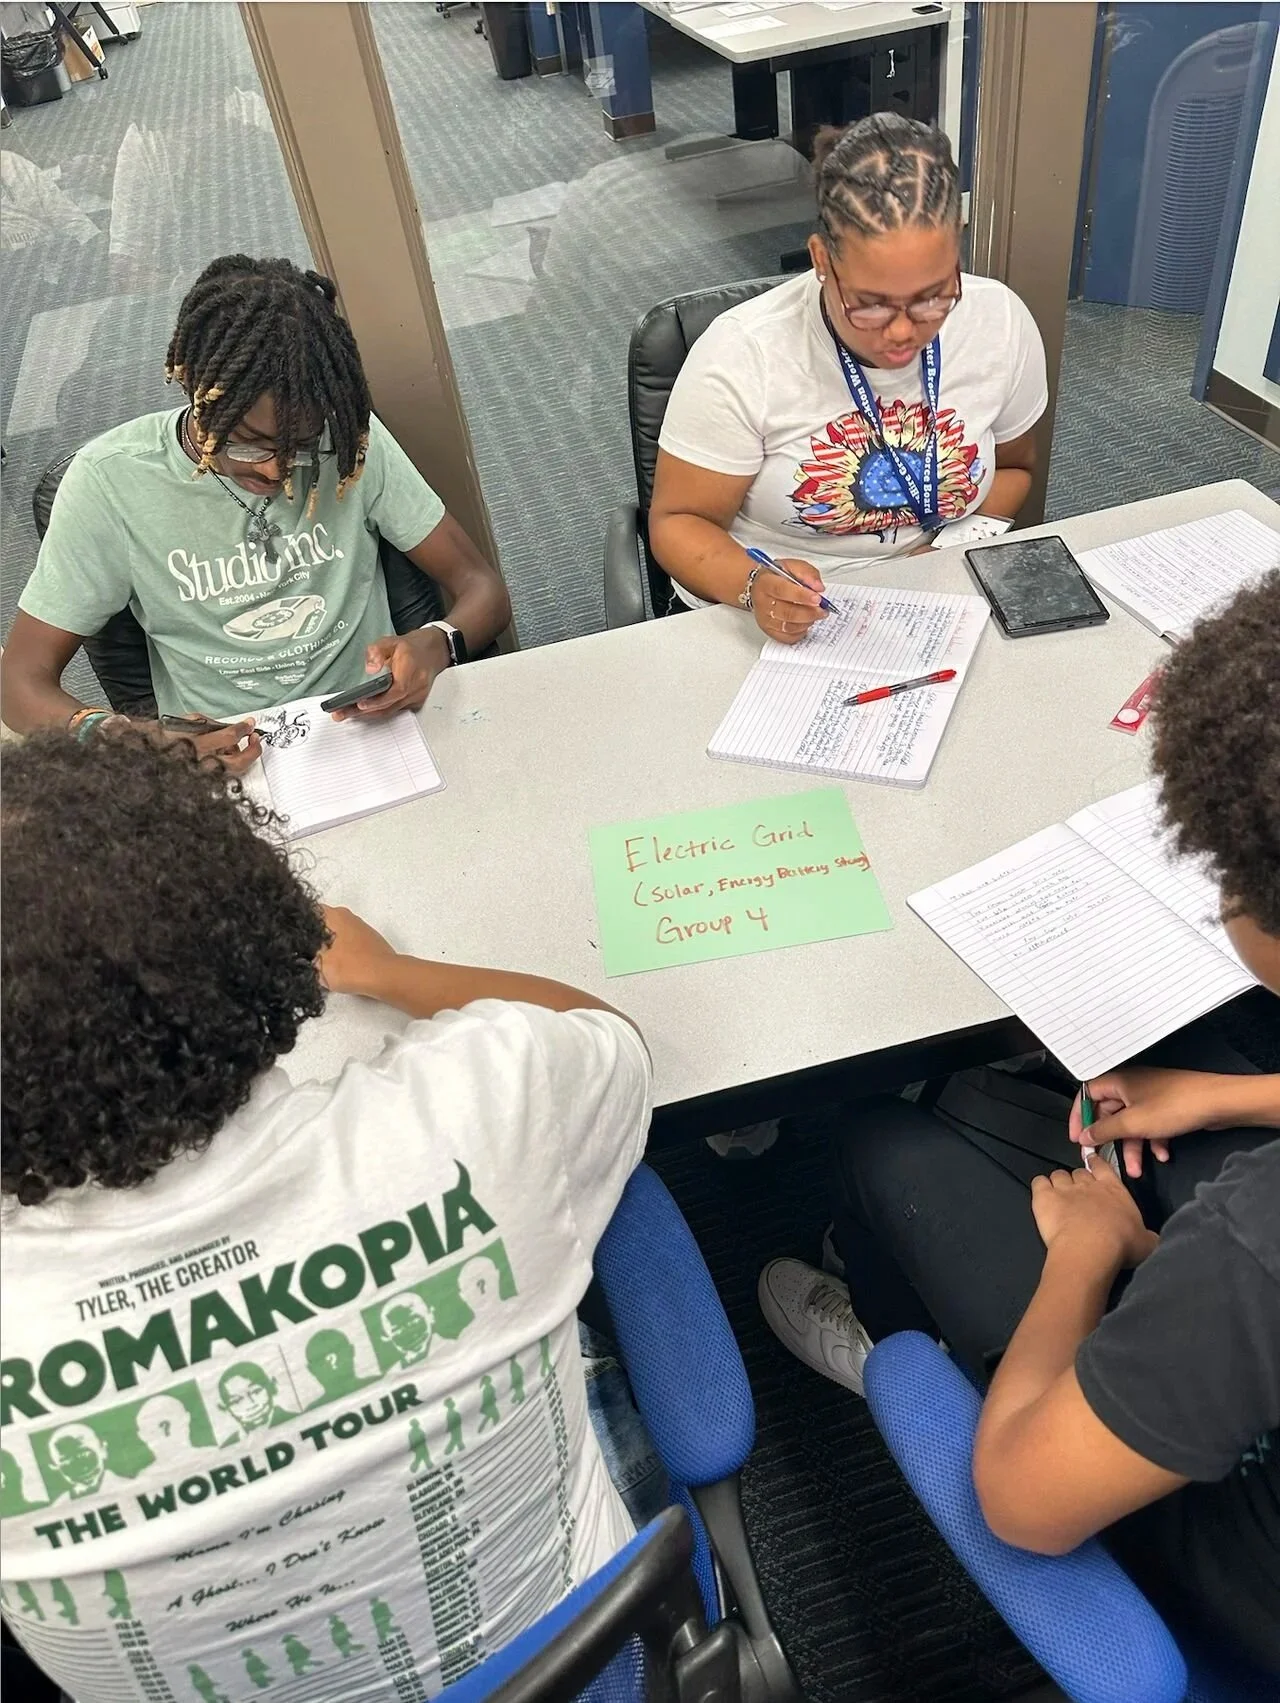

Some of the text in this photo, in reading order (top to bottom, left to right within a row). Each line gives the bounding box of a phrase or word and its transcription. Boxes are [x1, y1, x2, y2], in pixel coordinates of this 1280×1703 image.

[841, 346, 881, 436] rockton Workf
[927, 368, 936, 415] Brock
[923, 433, 934, 514] rkforce Board
[167, 541, 282, 602] Studio
[293, 572, 311, 582] City
[625, 821, 814, 872] Electric Grid
[656, 907, 768, 945] Group 4
[1, 1158, 497, 1427] ROMAKOPIA
[75, 1239, 260, 1322] TYLER, THE CREATOR
[34, 1382, 425, 1549] THE WORLD TOUR
[278, 1489, 346, 1527] Chasing
[165, 1595, 184, 1612] A
[282, 1540, 332, 1569] Don't
[337, 1517, 386, 1544] Know
[225, 1609, 279, 1632] Where
[285, 1594, 313, 1610] He
